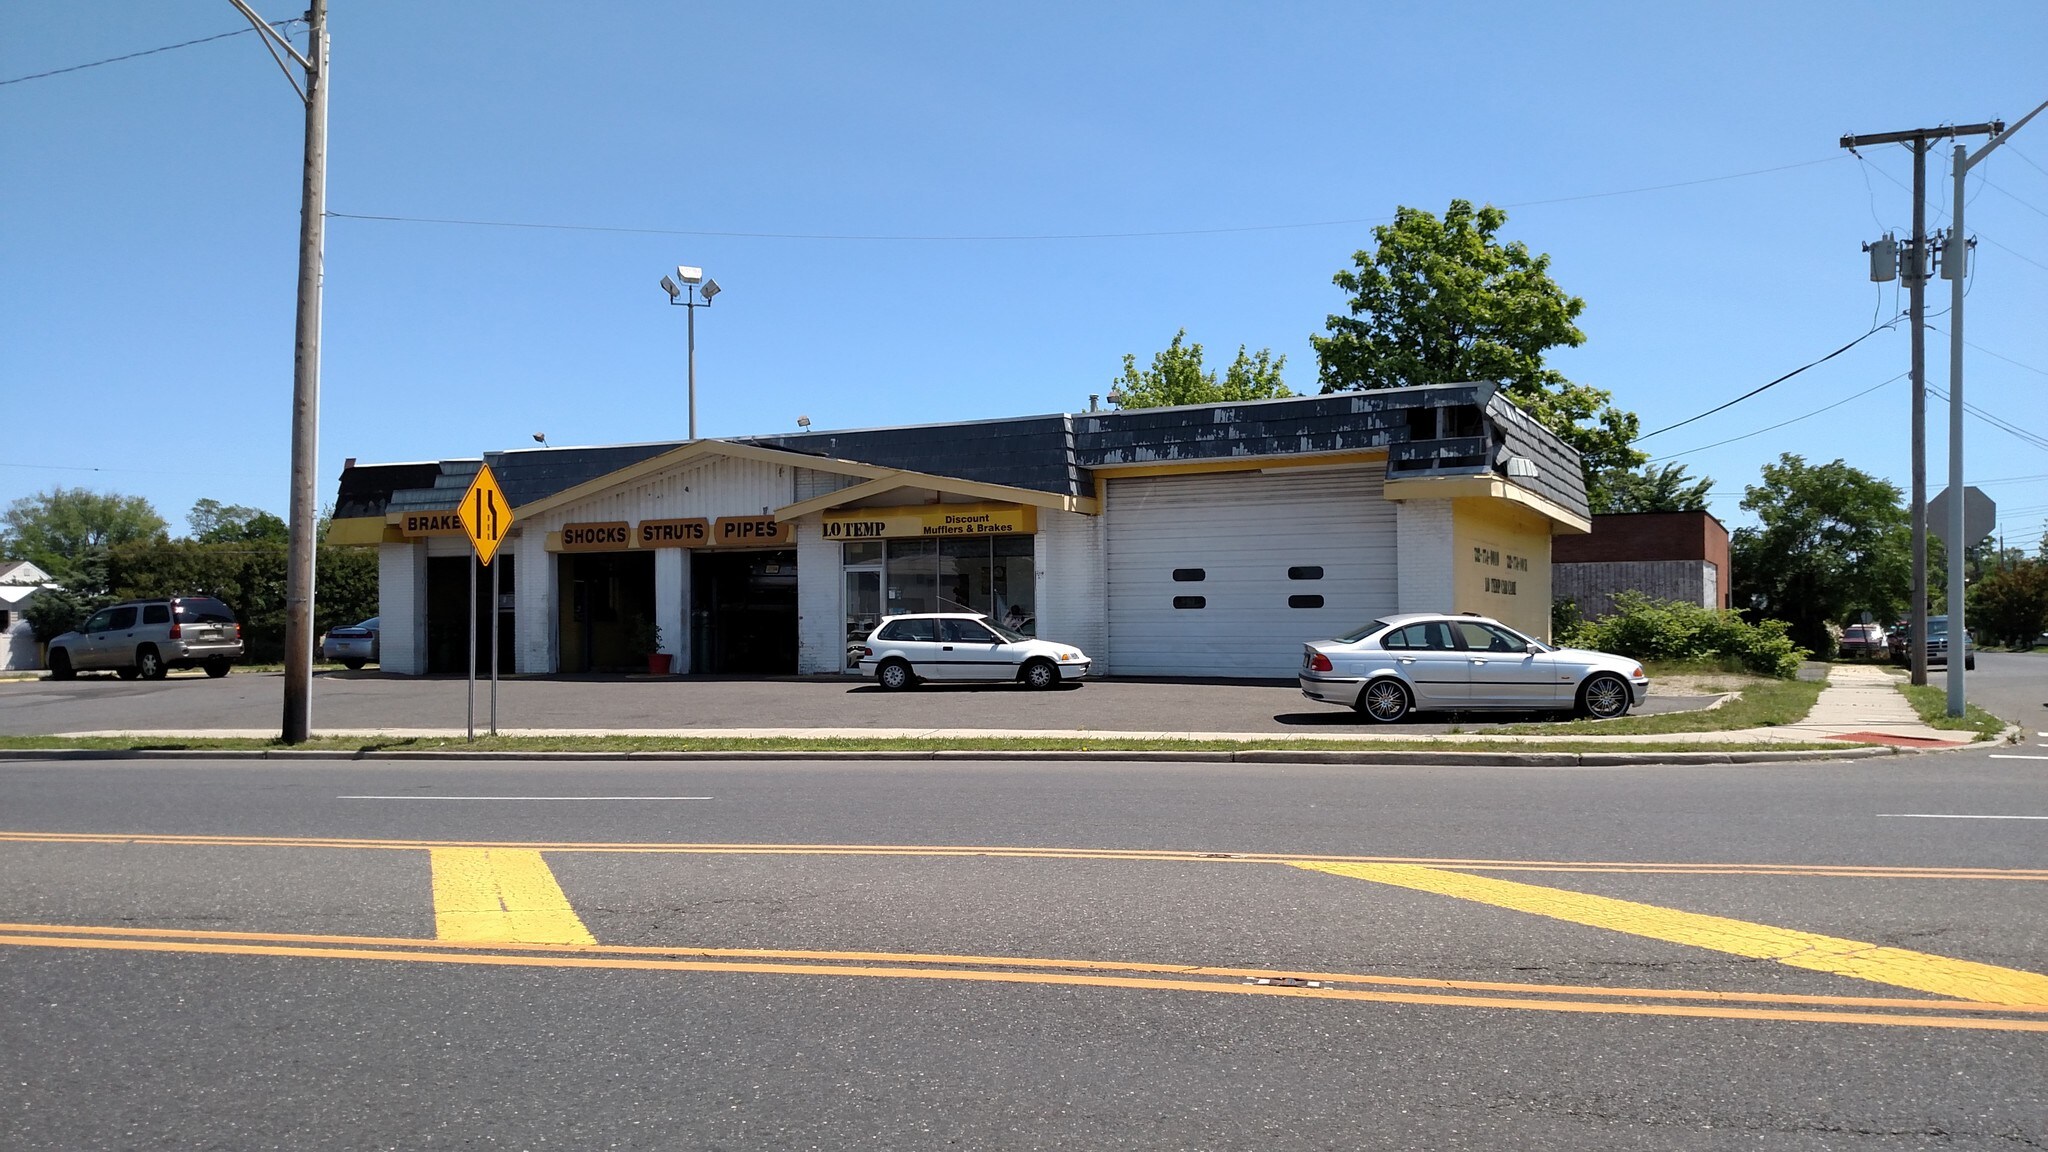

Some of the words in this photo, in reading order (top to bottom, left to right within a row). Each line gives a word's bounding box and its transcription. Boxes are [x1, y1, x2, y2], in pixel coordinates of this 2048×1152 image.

[408, 515, 465, 531] BRAKE
[945, 514, 990, 524] Discount
[564, 527, 627, 545] SHOCKS
[643, 523, 704, 541] STRUTS
[724, 521, 778, 538] PIPES
[823, 523, 841, 537] LO
[843, 522, 886, 537] TEMP
[923, 524, 964, 535] Mufflers
[966, 524, 974, 533] &
[977, 523, 1013, 533] Brakes
